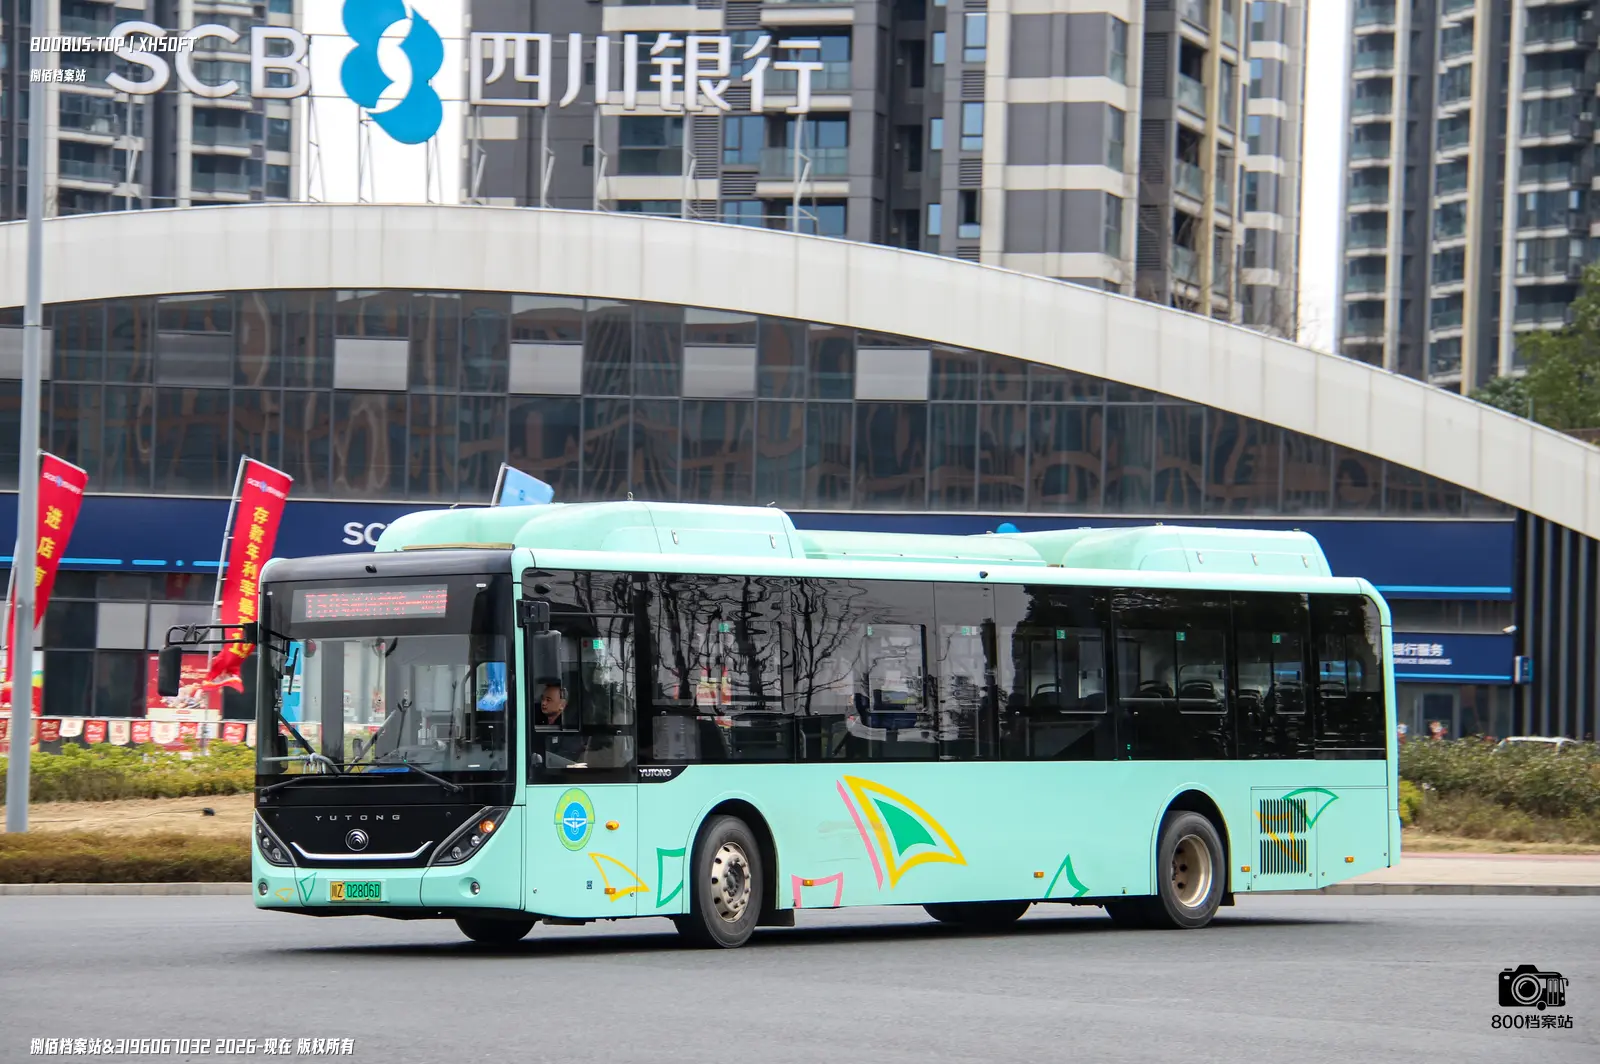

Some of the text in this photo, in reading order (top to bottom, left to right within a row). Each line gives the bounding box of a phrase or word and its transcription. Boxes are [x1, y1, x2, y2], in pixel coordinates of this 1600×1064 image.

[104, 20, 311, 98] SCB
[470, 32, 824, 114] 四川银行
[342, 521, 392, 546] SC
[638, 768, 673, 778] YUTONG
